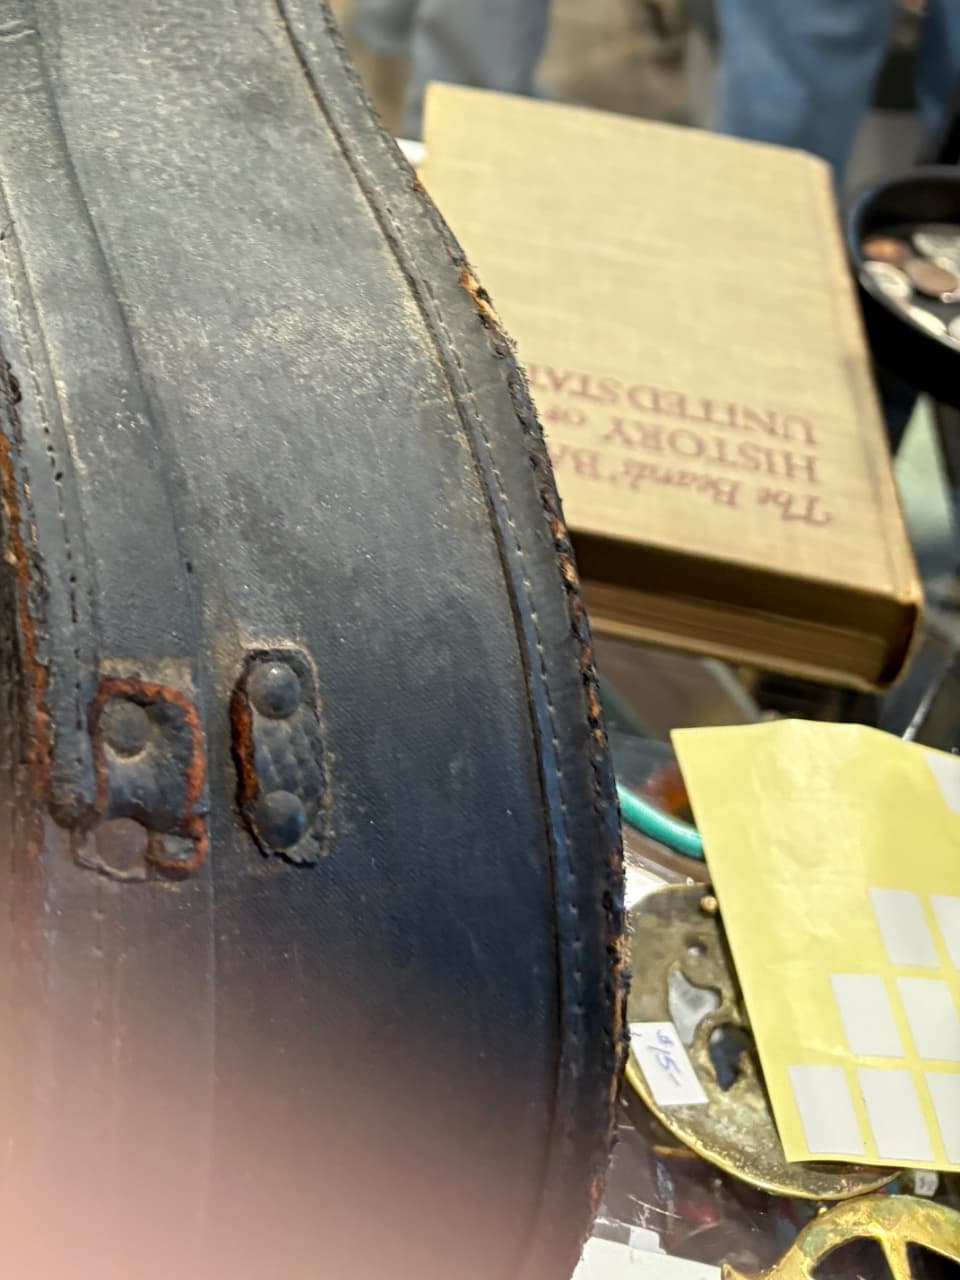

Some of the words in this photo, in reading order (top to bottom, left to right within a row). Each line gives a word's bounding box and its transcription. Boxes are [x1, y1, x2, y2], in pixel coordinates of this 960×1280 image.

[627, 384, 817, 447] UNITED
[603, 416, 819, 484] HISTORY
[758, 488, 832, 527] The
